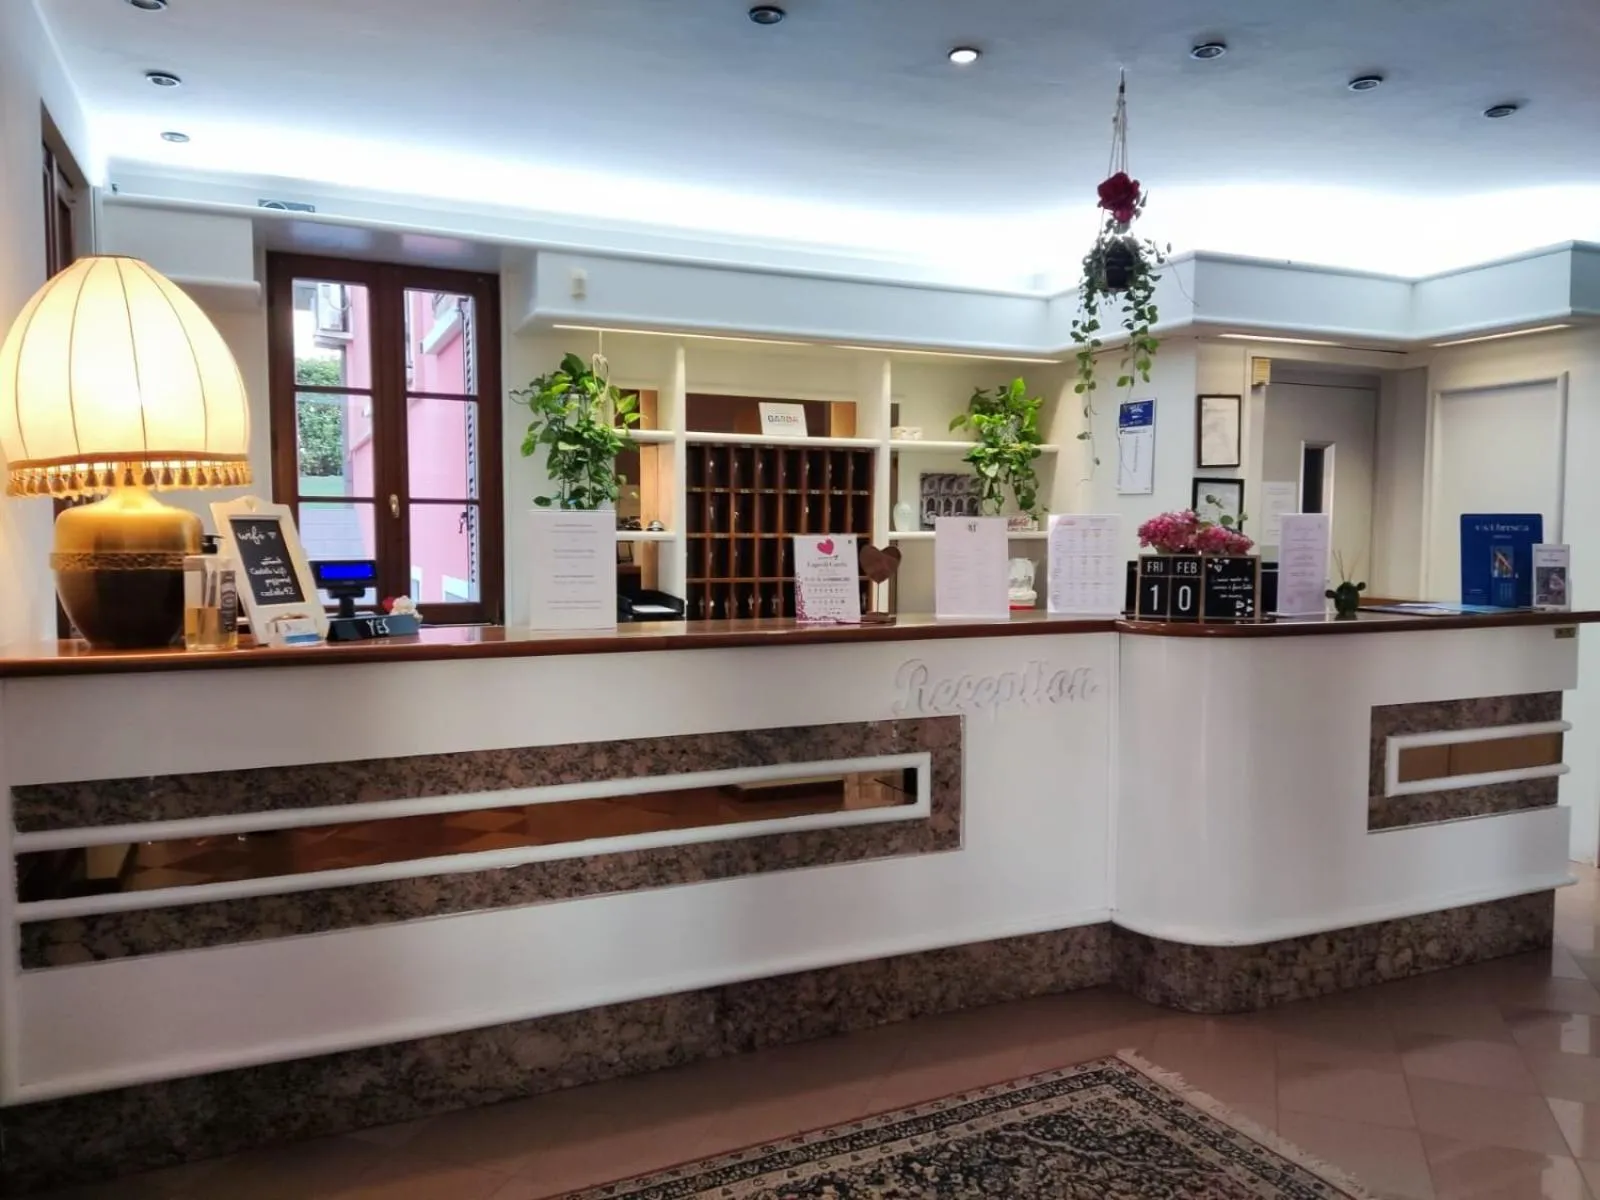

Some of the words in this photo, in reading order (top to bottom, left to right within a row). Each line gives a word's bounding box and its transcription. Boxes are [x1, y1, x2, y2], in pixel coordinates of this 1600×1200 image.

[1147, 561, 1164, 573] FRI
[1176, 561, 1197, 574] FEB
[365, 618, 390, 636] YES
[892, 658, 1099, 722] Reception
